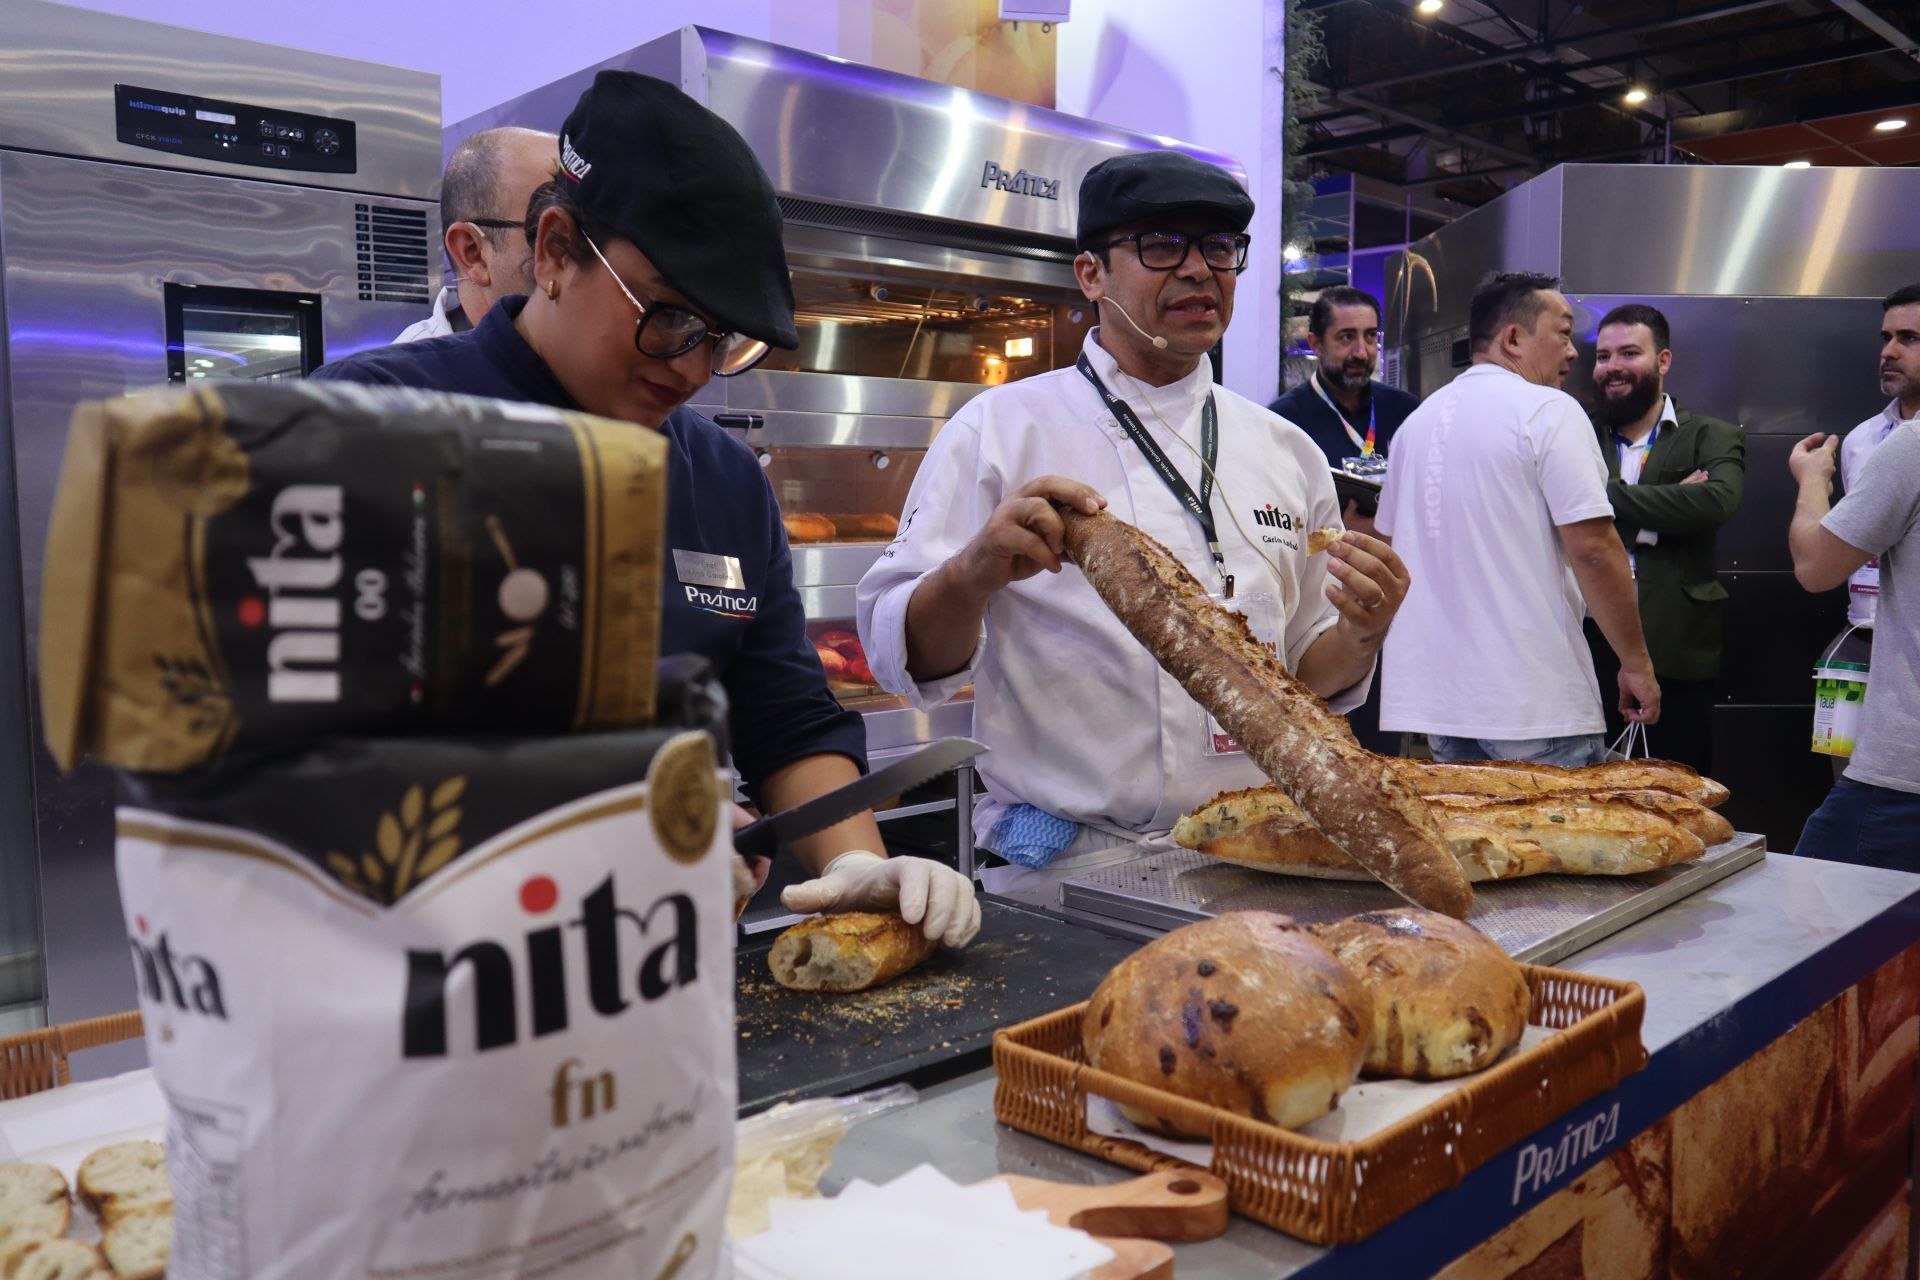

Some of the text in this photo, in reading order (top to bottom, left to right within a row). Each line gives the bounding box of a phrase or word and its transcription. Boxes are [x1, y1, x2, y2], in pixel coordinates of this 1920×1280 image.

[158, 135, 183, 145] VISION
[981, 160, 1061, 200] PRÁTICA
[1138, 433, 1161, 463] Conhecimento
[239, 484, 346, 702] nita
[684, 586, 757, 611] PRÁTICA
[402, 873, 699, 1059] nita
[548, 1058, 617, 1129] fn
[1512, 1102, 1621, 1206] PRÁTICA
